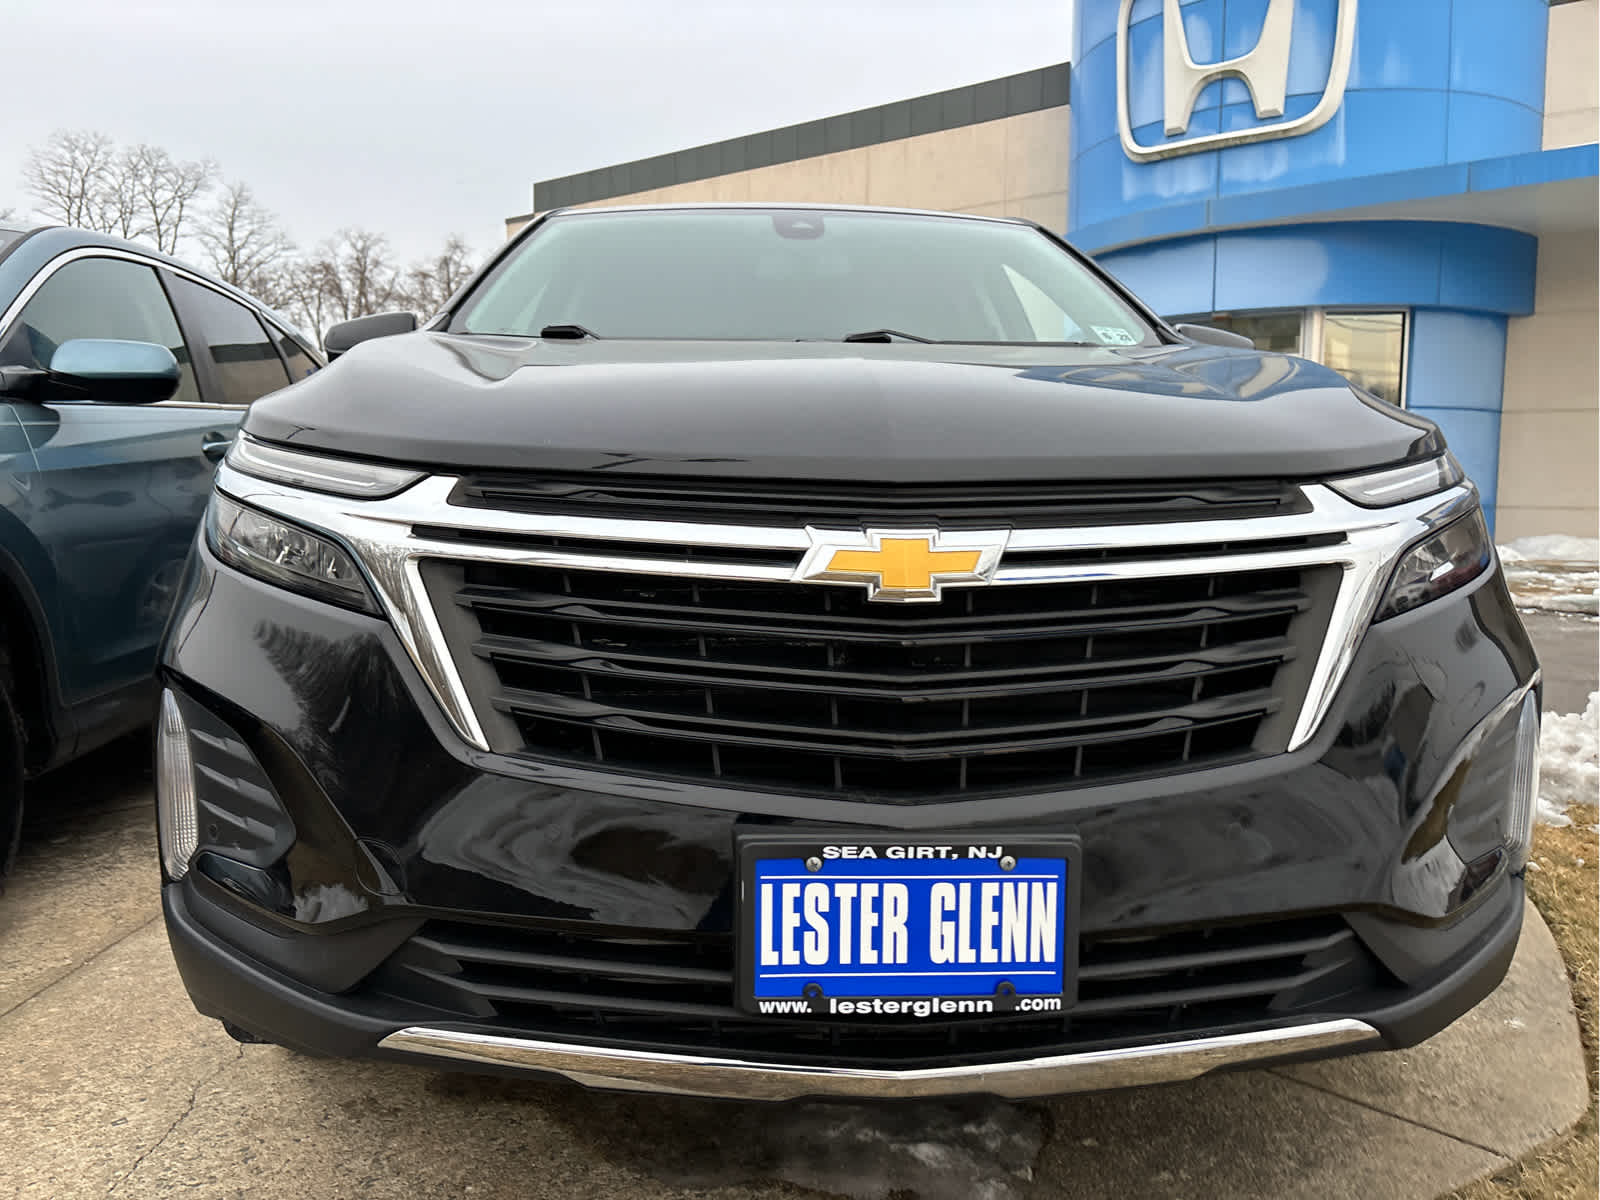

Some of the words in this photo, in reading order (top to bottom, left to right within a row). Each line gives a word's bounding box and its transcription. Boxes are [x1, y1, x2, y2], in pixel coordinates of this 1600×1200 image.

[822, 846, 878, 859] SEA
[885, 846, 959, 861] GIRT,
[968, 846, 1003, 859] NJ
[760, 882, 909, 966] LESTER
[929, 881, 1058, 964] GLENN
[759, 1000, 812, 1014] www.
[829, 997, 993, 1017] lesterglenn
[1015, 997, 1062, 1012] .com
